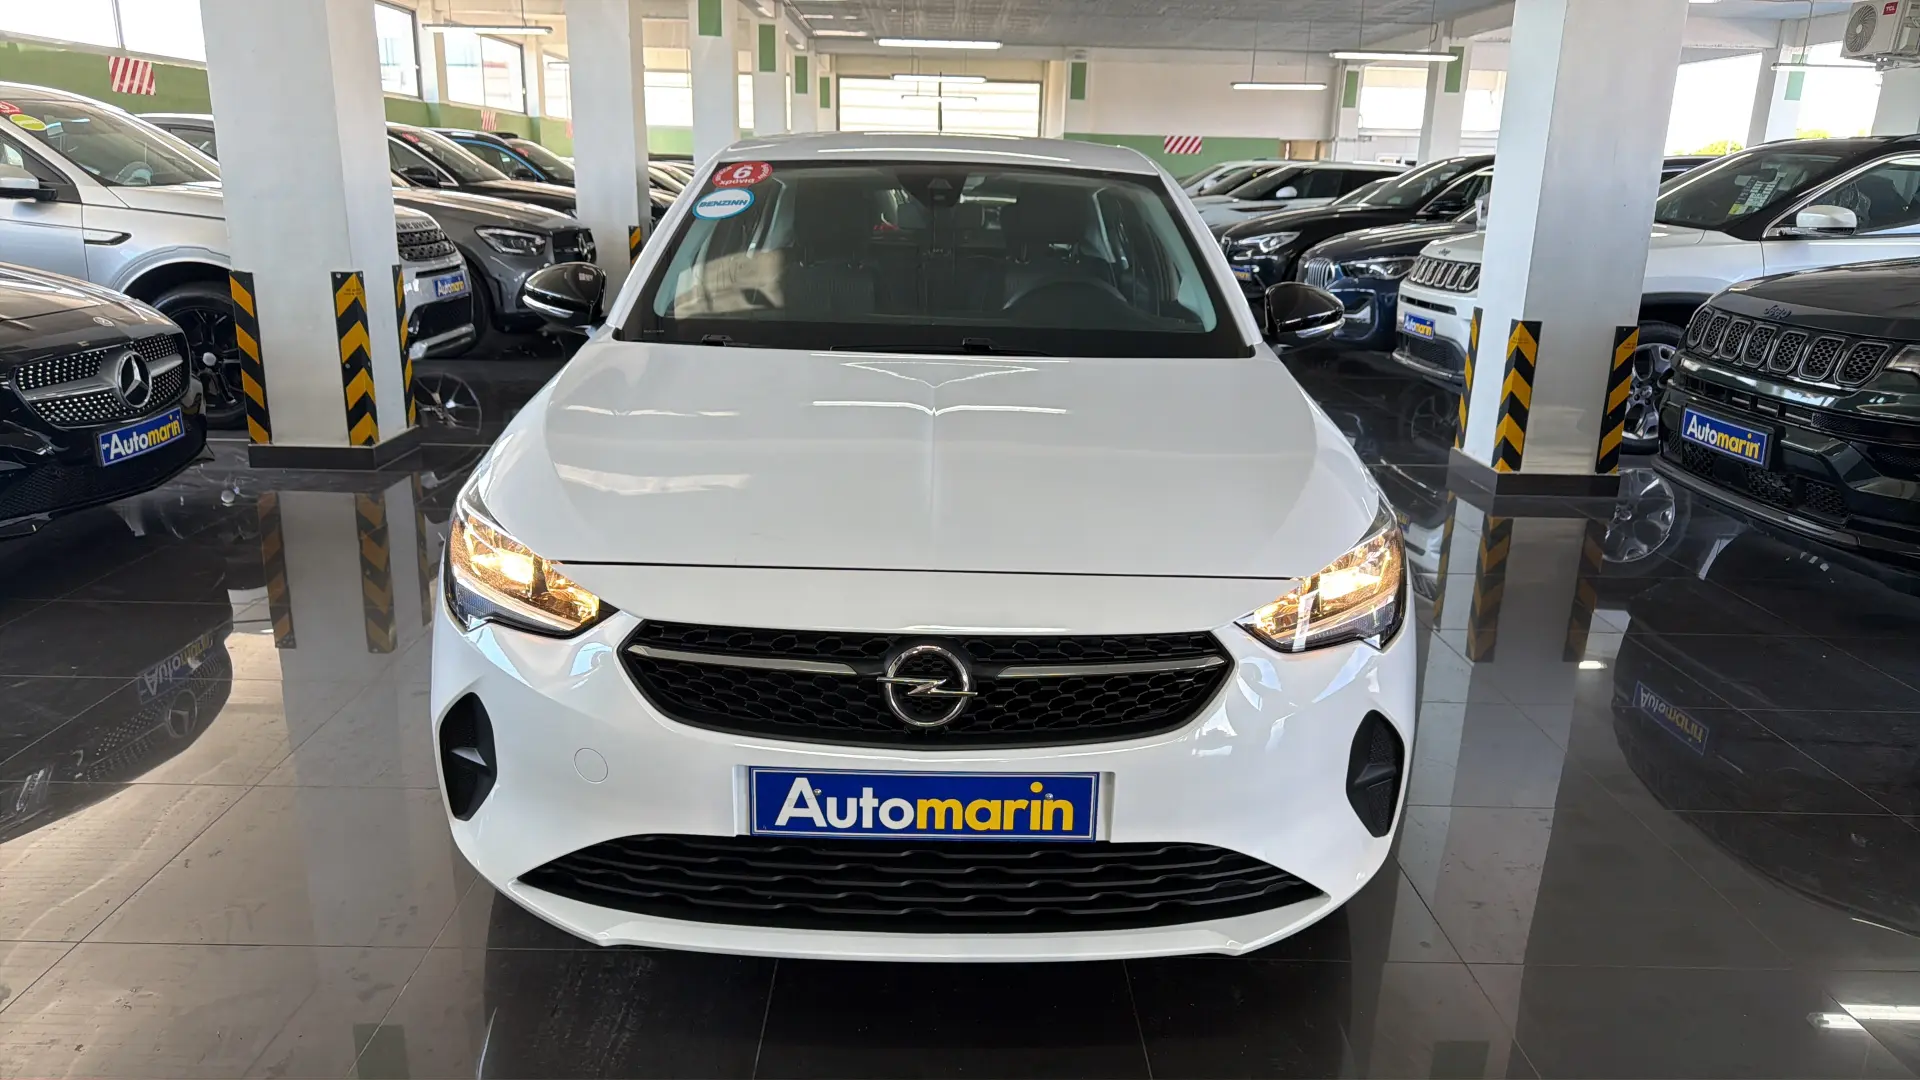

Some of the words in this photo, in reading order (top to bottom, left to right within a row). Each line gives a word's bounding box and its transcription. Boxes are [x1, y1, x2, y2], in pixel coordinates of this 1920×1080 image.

[733, 166, 753, 179] 6
[109, 414, 181, 460] Automarin
[1686, 414, 1760, 459] Automarin
[774, 777, 1074, 831] Automarin
